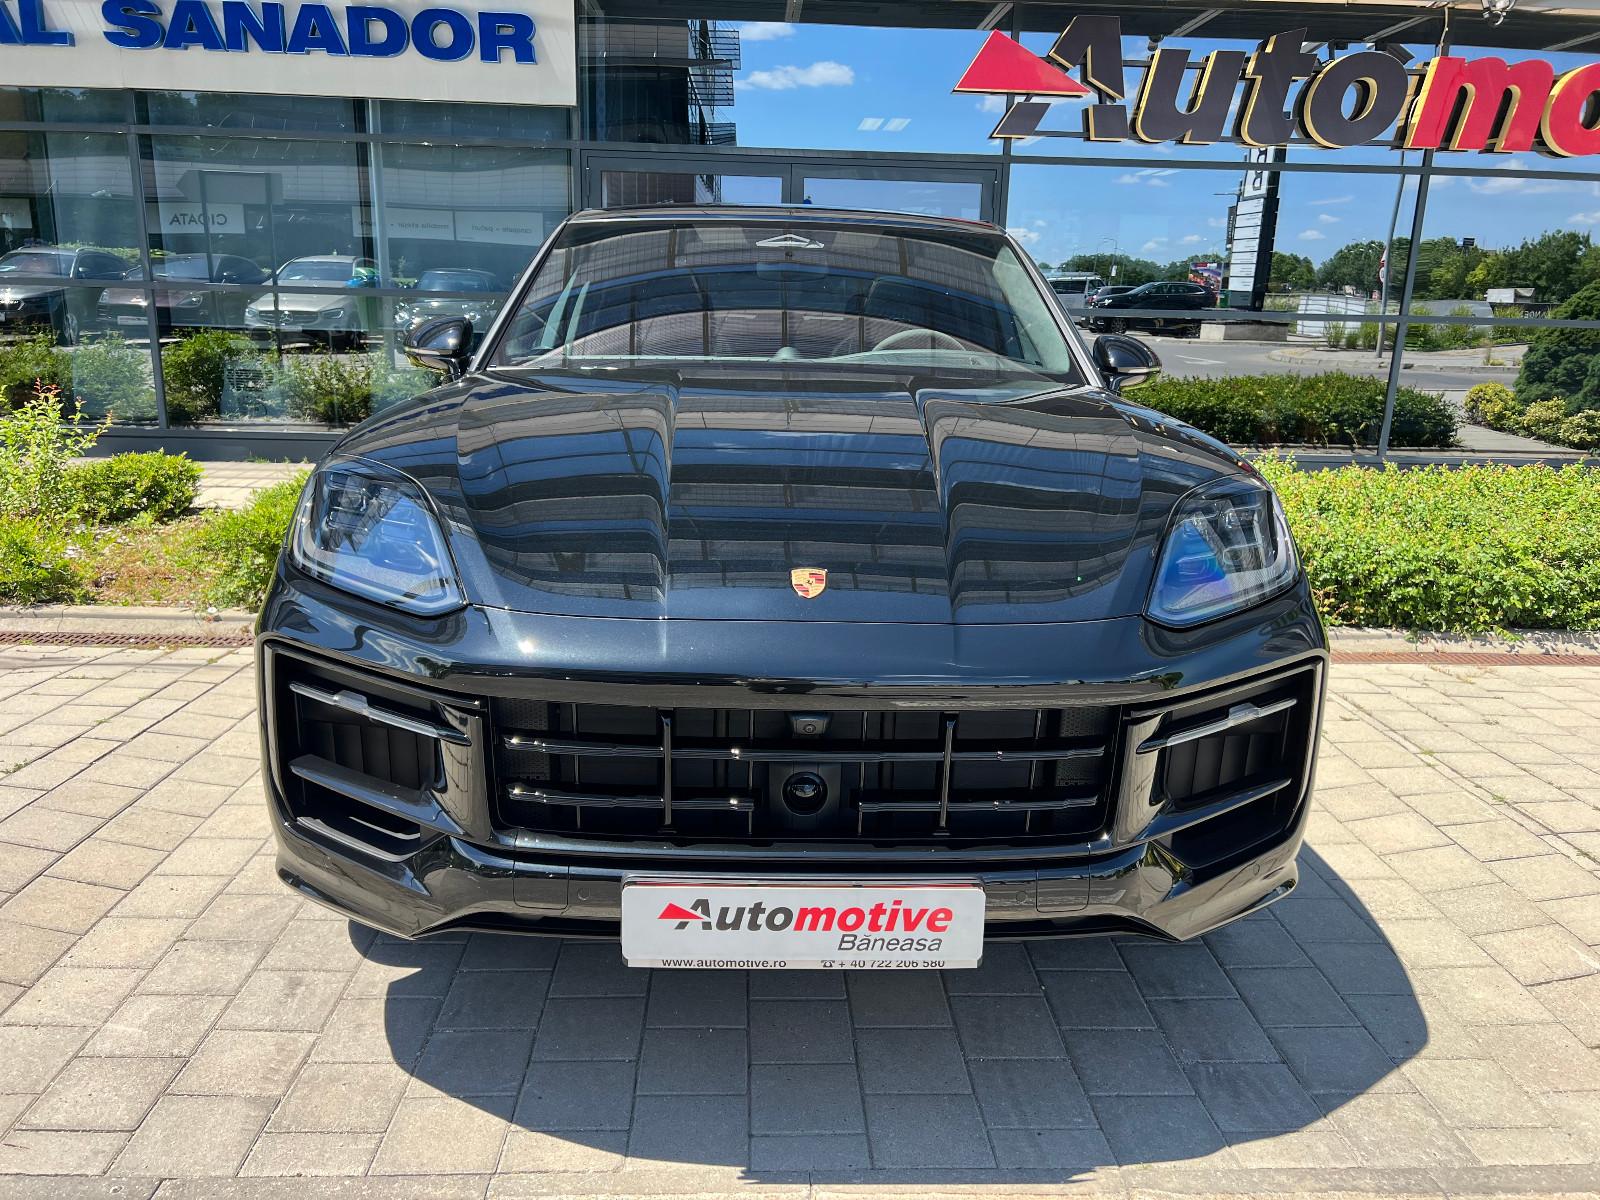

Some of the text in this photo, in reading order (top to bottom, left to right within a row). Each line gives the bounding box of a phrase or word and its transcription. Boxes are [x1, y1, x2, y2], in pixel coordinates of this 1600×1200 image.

[102, 0, 538, 65] SANADOR
[657, 898, 953, 933] Automotive
[837, 933, 943, 952] Băneasa
[661, 958, 787, 969] www.automotive.ro
[870, 959, 892, 968] 722
